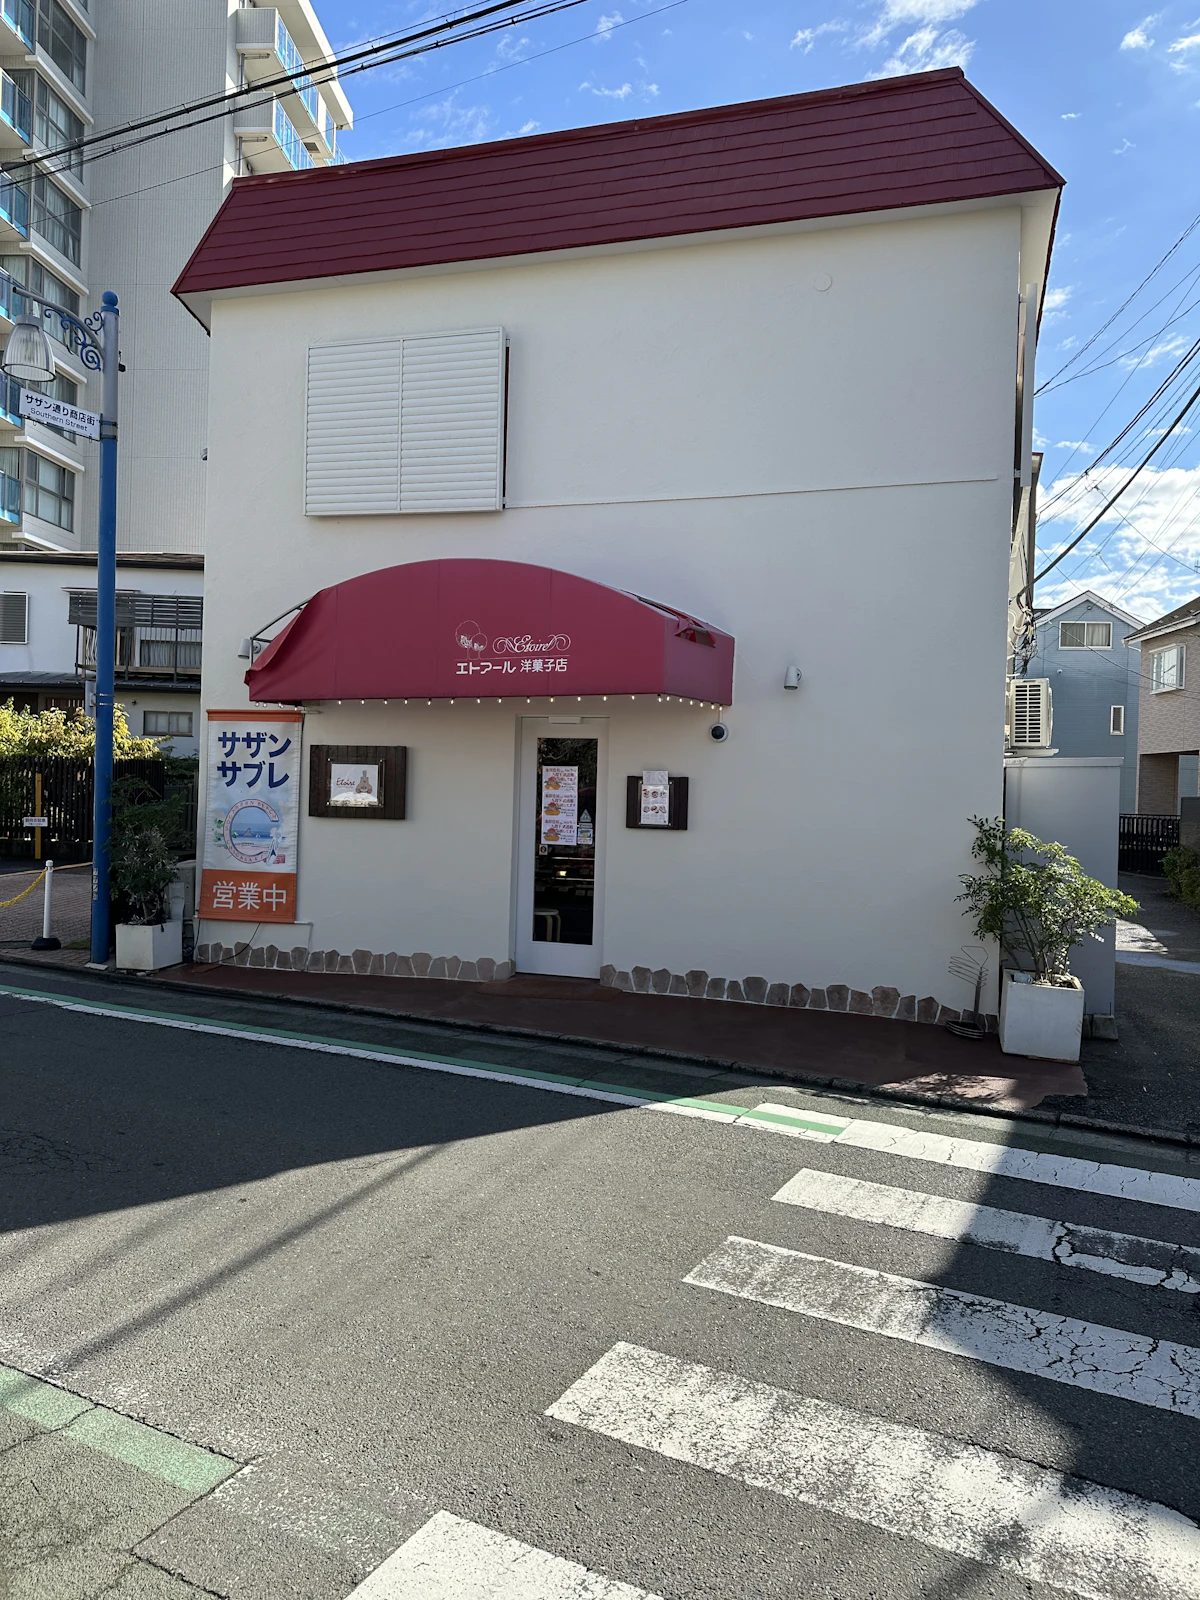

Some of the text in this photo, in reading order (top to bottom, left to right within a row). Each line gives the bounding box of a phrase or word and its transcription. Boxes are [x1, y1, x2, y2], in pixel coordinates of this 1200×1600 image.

[25, 394, 95, 426] サザン通り商店街
[30, 407, 88, 431] Southern Street
[456, 658, 568, 675] エトアール 洋菓子店
[217, 731, 292, 758] サザン
[217, 760, 290, 788] サブレ
[212, 880, 287, 912] 営業中
